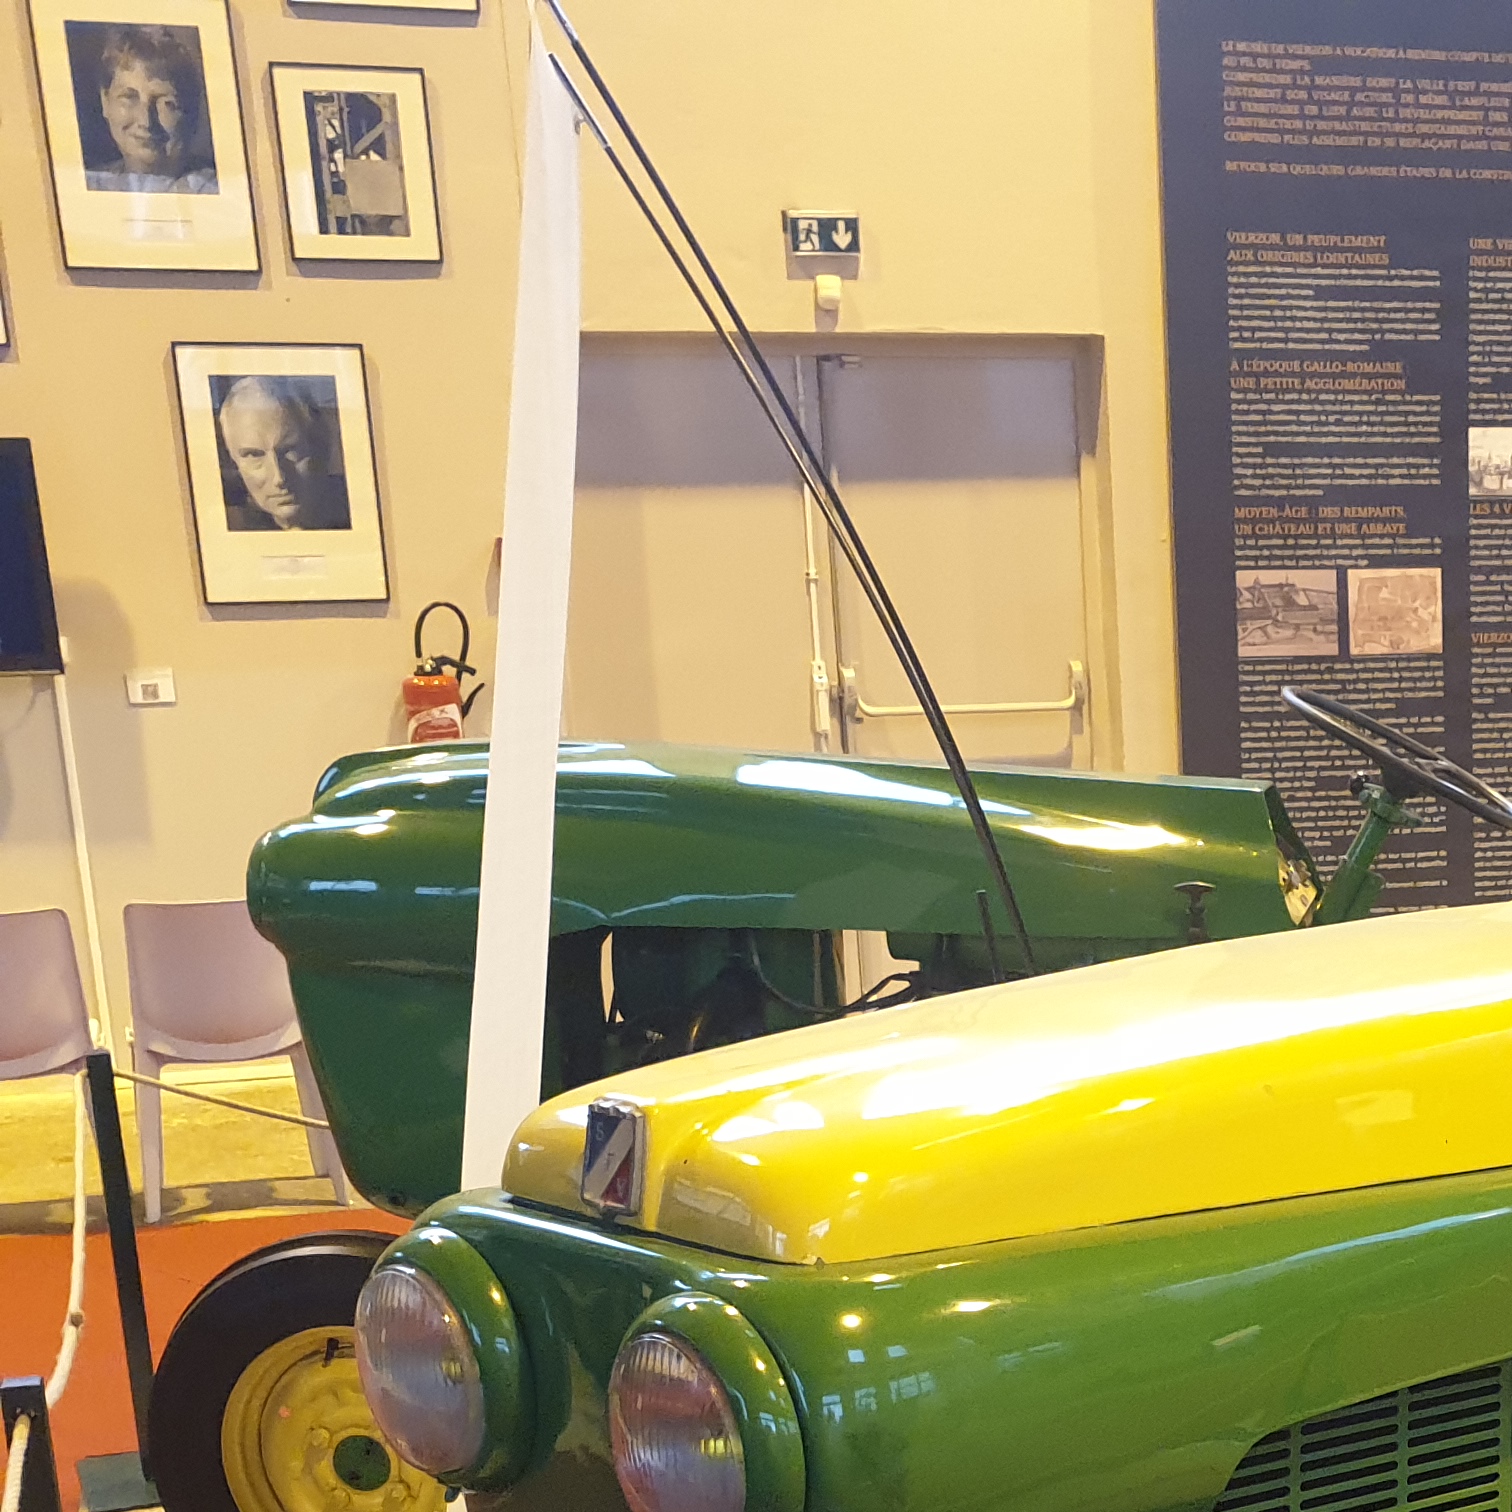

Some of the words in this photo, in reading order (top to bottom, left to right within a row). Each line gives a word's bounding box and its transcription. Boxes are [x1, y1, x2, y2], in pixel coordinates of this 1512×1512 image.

[1287, 234, 1303, 245] UN
[1307, 235, 1386, 247] PEUPLEMENT
[1469, 238, 1493, 250] UNE
[1226, 250, 1254, 261] AUX
[1257, 251, 1314, 263] ORIGINES
[1317, 253, 1389, 265] LOINTAINES
[1303, 361, 1403, 373] GALLO-ROMAINE
[1231, 377, 1256, 388] UNE
[1260, 378, 1300, 389] PETITE
[1303, 376, 1406, 390] AGGLOMÉRATION
[1318, 507, 1341, 518] DES
[1470, 503, 1491, 514] LES
[1235, 524, 1252, 535] UN
[1255, 521, 1314, 535] CHÂTEAU
[1317, 523, 1331, 534] ET
[1334, 523, 1358, 535] UNE
[1361, 523, 1406, 535] ABBAYE
